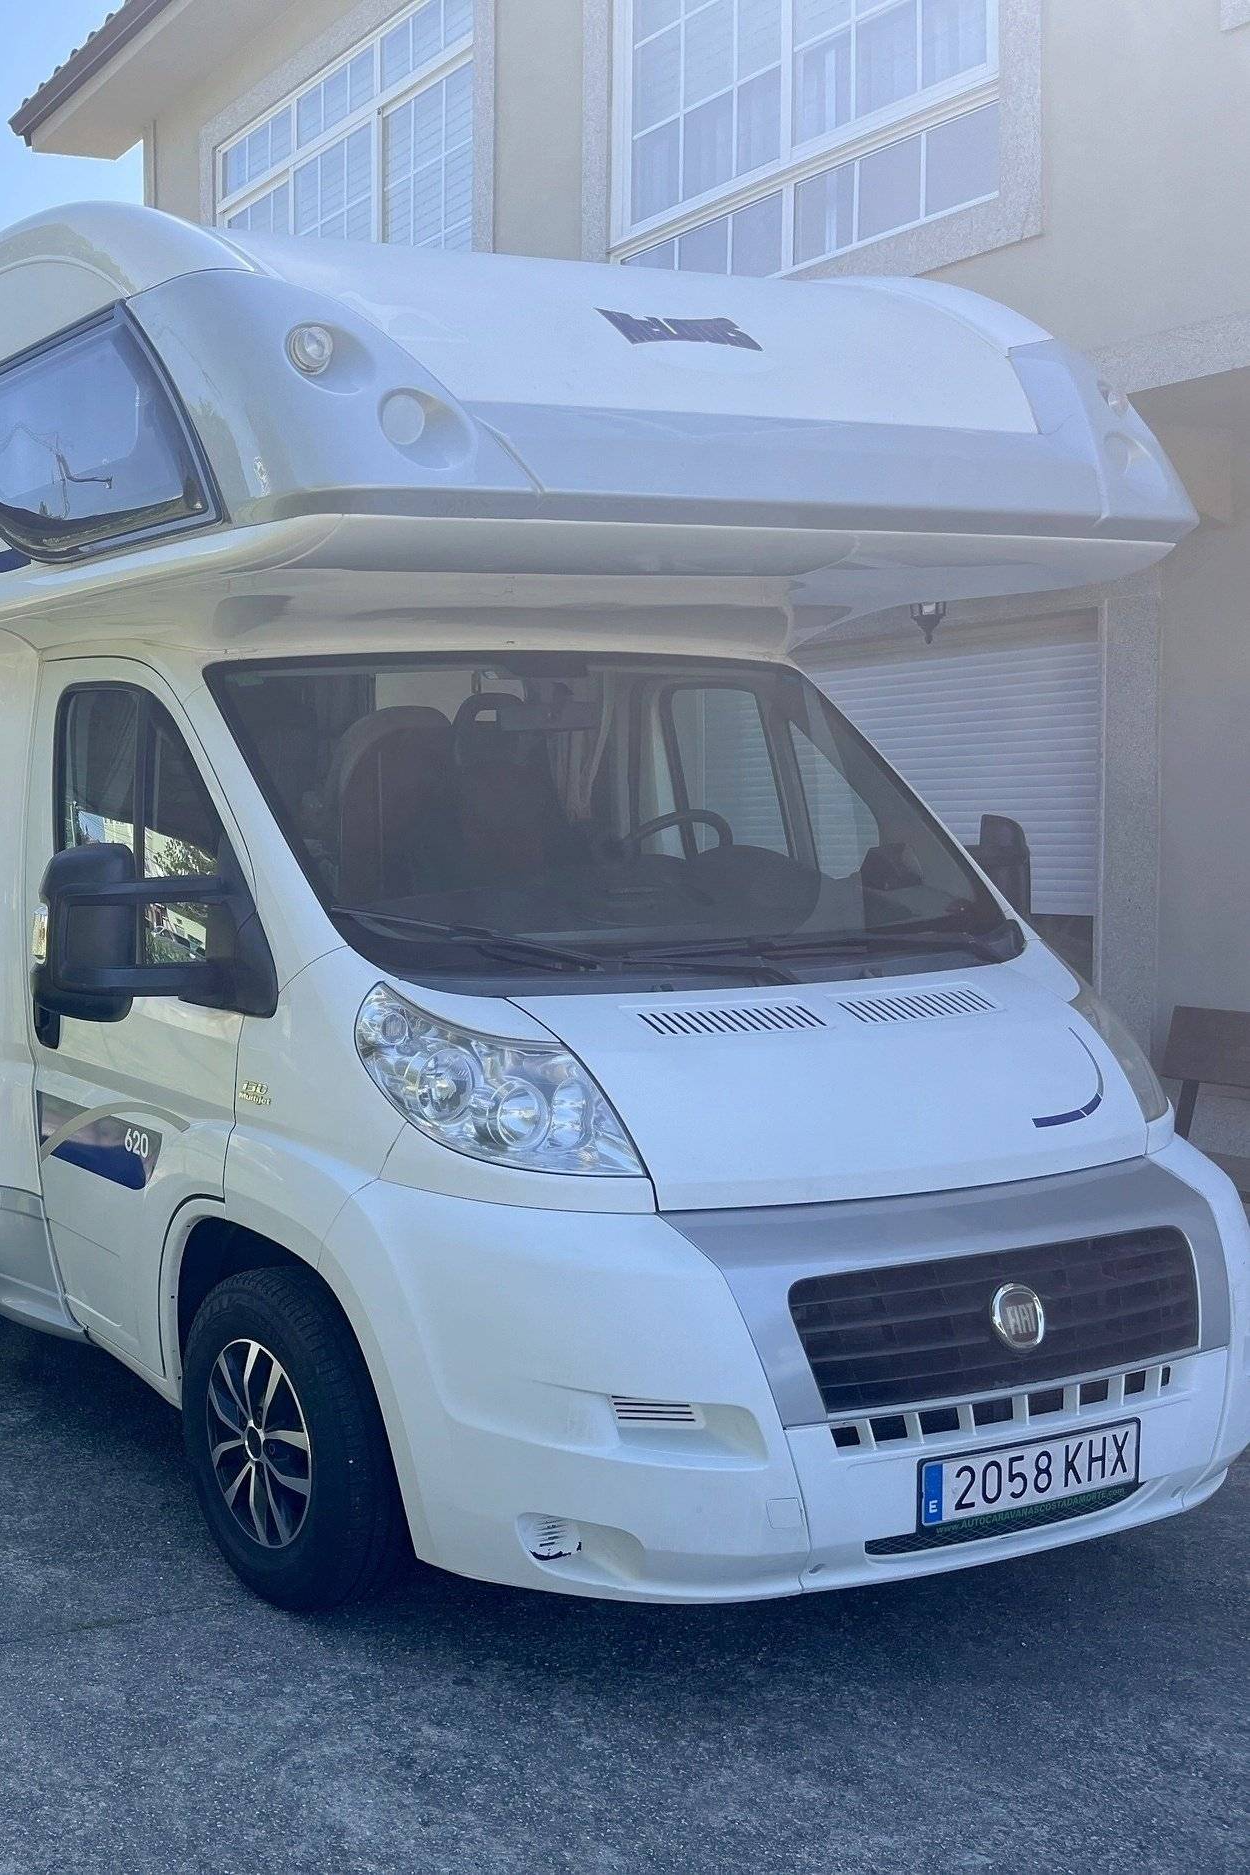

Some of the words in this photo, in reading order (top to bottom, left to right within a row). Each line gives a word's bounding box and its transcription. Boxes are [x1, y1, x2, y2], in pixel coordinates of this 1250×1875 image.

[124, 1128, 149, 1158] 620
[1006, 1302, 1036, 1335] FIAT
[928, 1499, 938, 1514] E
[954, 1450, 1052, 1511] 2058
[1063, 1430, 1130, 1488] KHX
